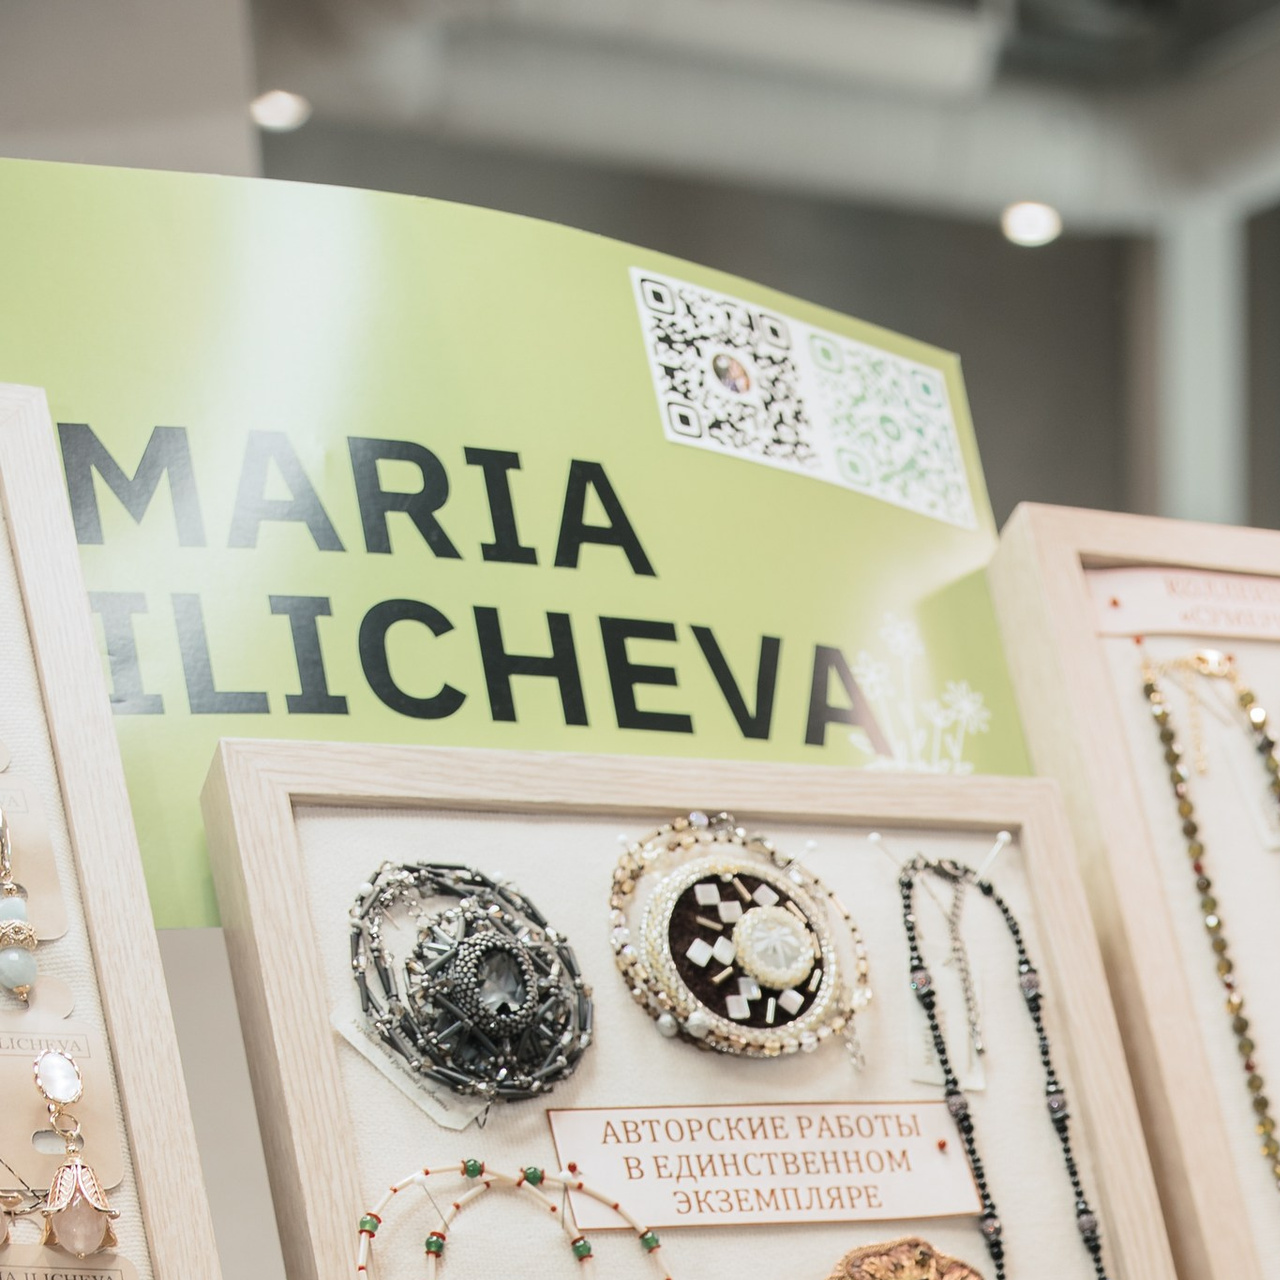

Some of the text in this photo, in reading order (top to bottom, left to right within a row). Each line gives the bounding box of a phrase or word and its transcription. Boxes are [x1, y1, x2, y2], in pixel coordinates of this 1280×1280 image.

[57, 421, 658, 579] MARIA
[90, 591, 894, 757] ILICHEVA
[0, 1036, 81, 1052] LICHEVA
[601, 1113, 922, 1145] АВТОРСКИЕ РАБОТЫ
[623, 1149, 913, 1183] В ЕДИНСТВЕННОМ
[672, 1184, 883, 1215] ЭКЗЕМПЛЯРЕ
